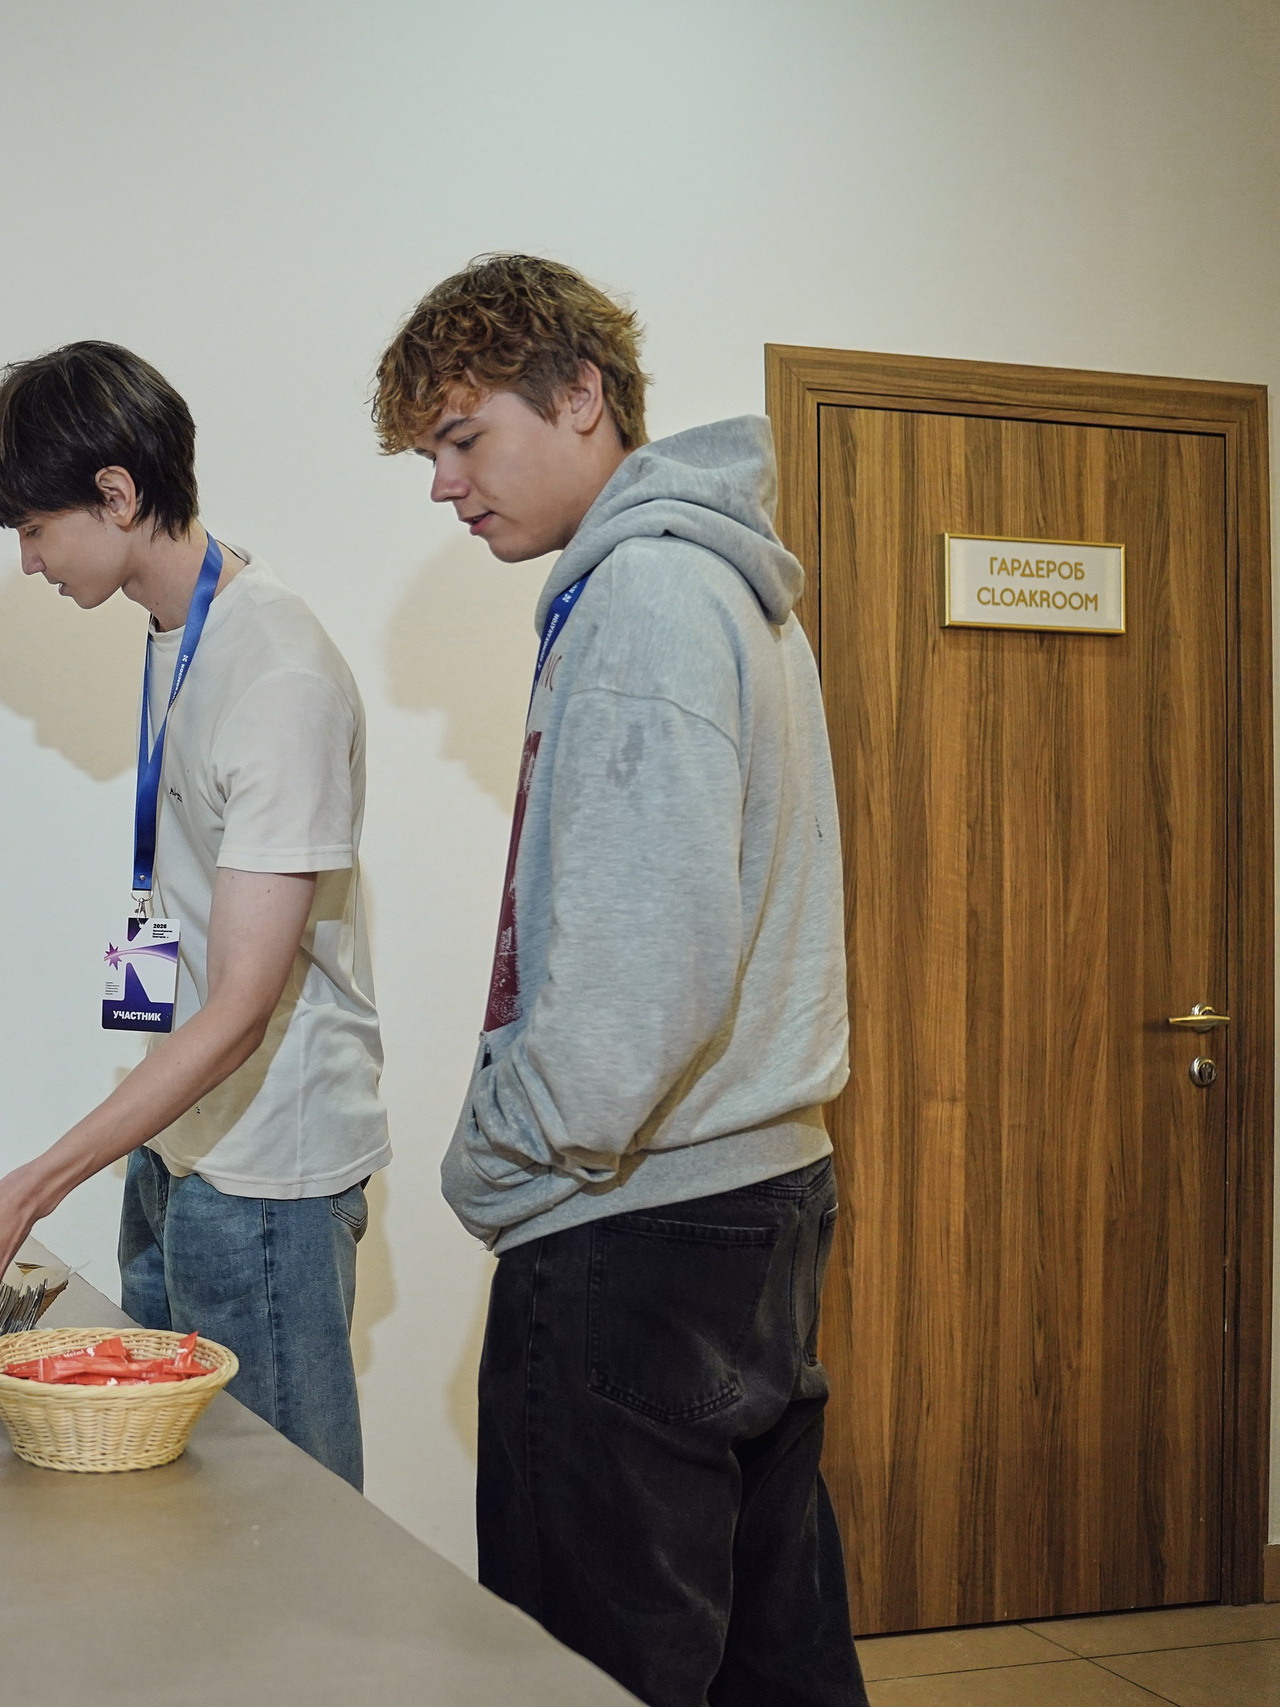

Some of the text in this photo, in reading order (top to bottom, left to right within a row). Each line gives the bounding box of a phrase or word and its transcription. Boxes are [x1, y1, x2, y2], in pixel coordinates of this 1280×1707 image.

[989, 556, 1085, 580] ГАРДЕРОБ
[977, 586, 1099, 612] CLOAKROOM
[112, 1010, 162, 1021] УЧАСТНИК
